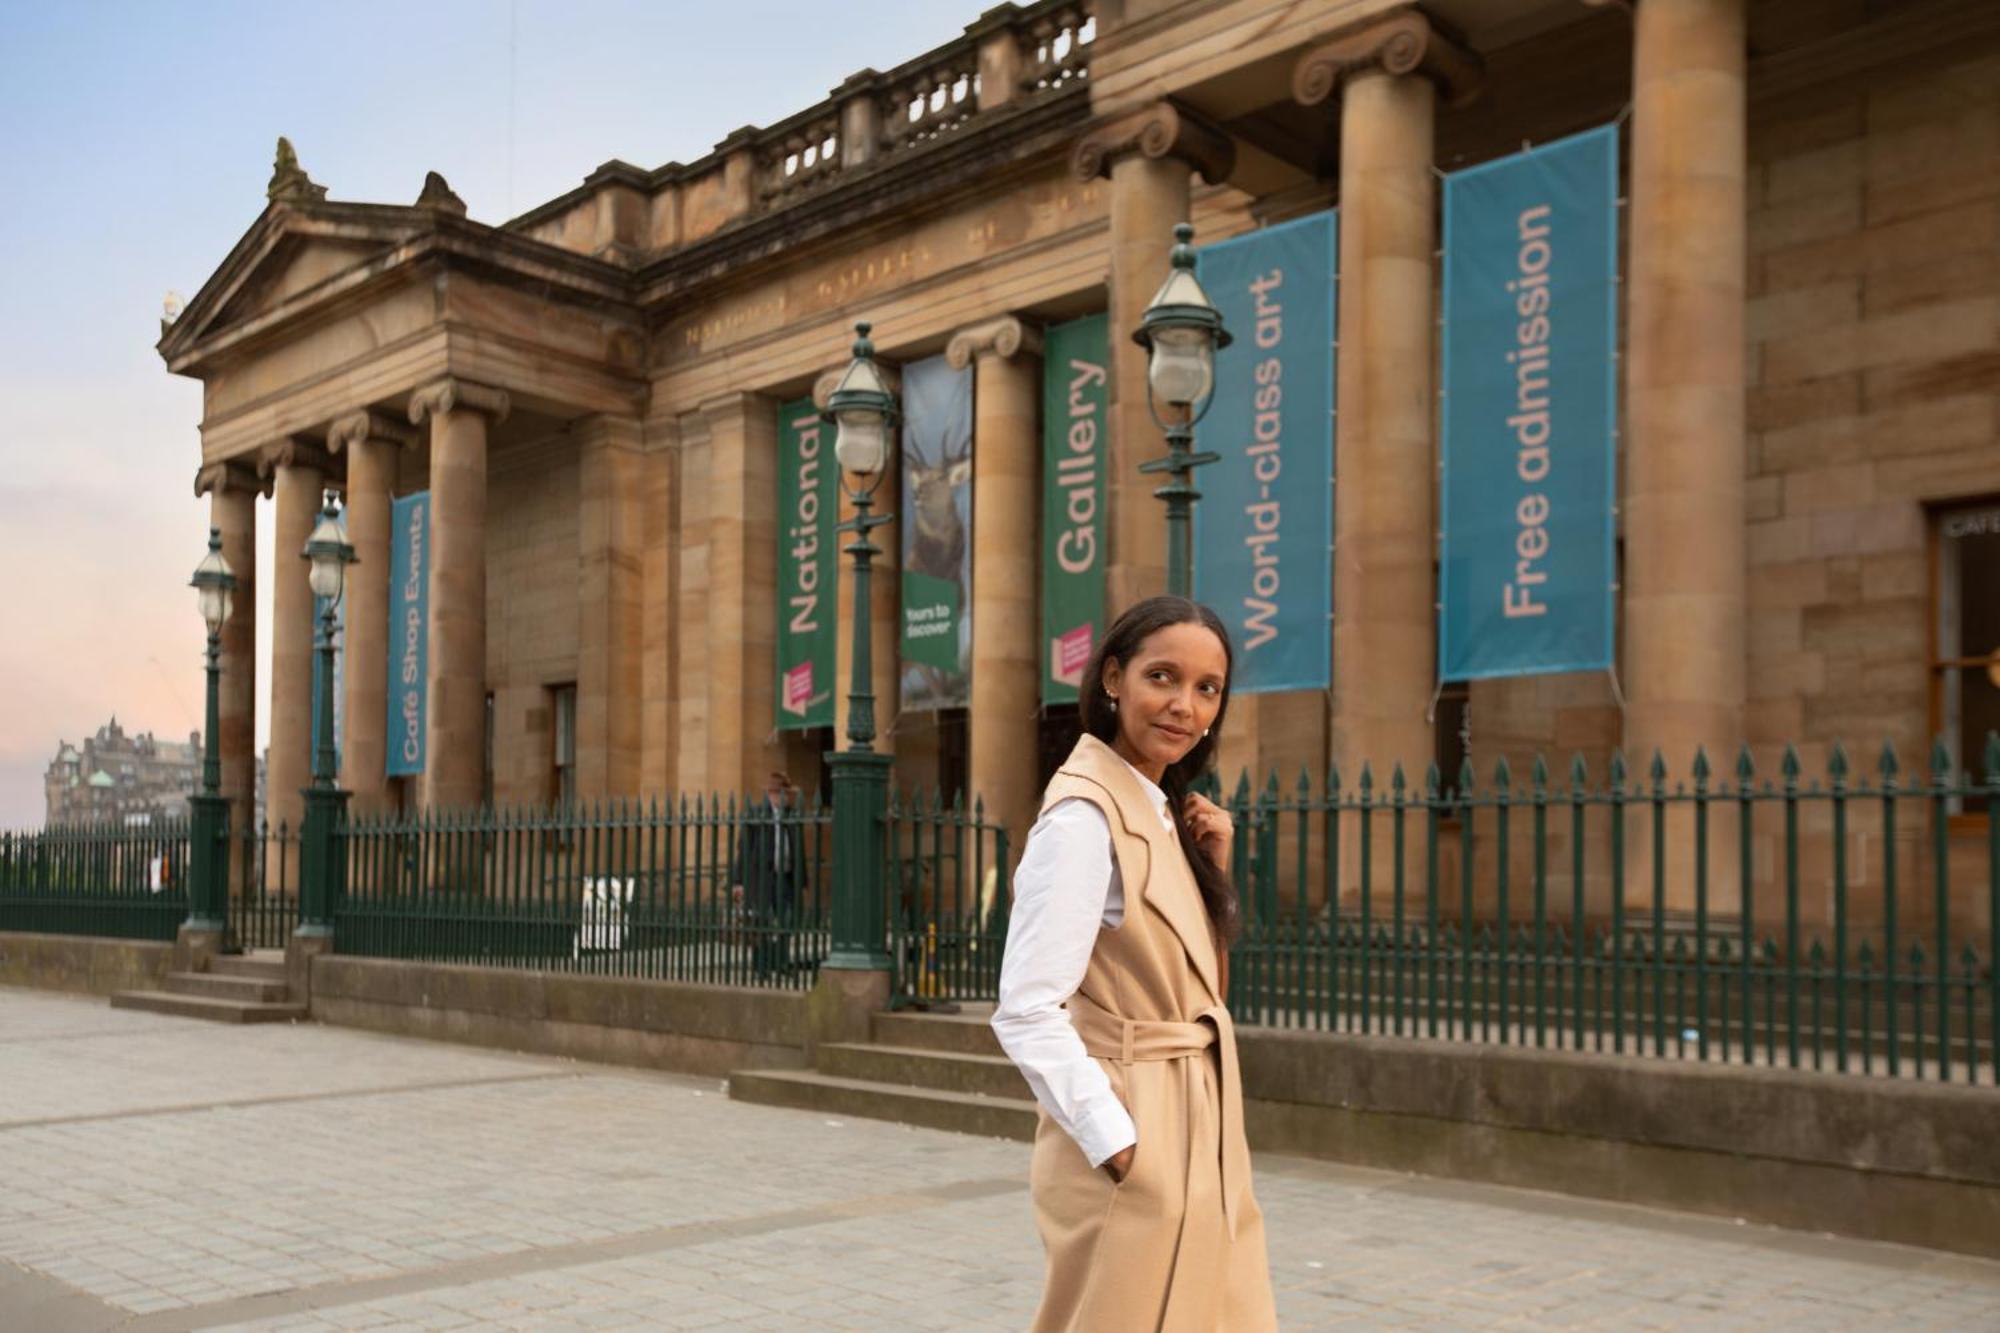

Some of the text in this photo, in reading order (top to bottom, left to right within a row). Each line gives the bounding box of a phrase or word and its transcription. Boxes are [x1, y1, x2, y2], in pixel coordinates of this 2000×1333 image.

[1057, 359, 1106, 574] Gallery
[1243, 268, 1283, 651] World-class art
[1503, 204, 1552, 618] Free admission
[405, 504, 423, 601] Events
[790, 414, 820, 634] National
[403, 607, 420, 684] Shop
